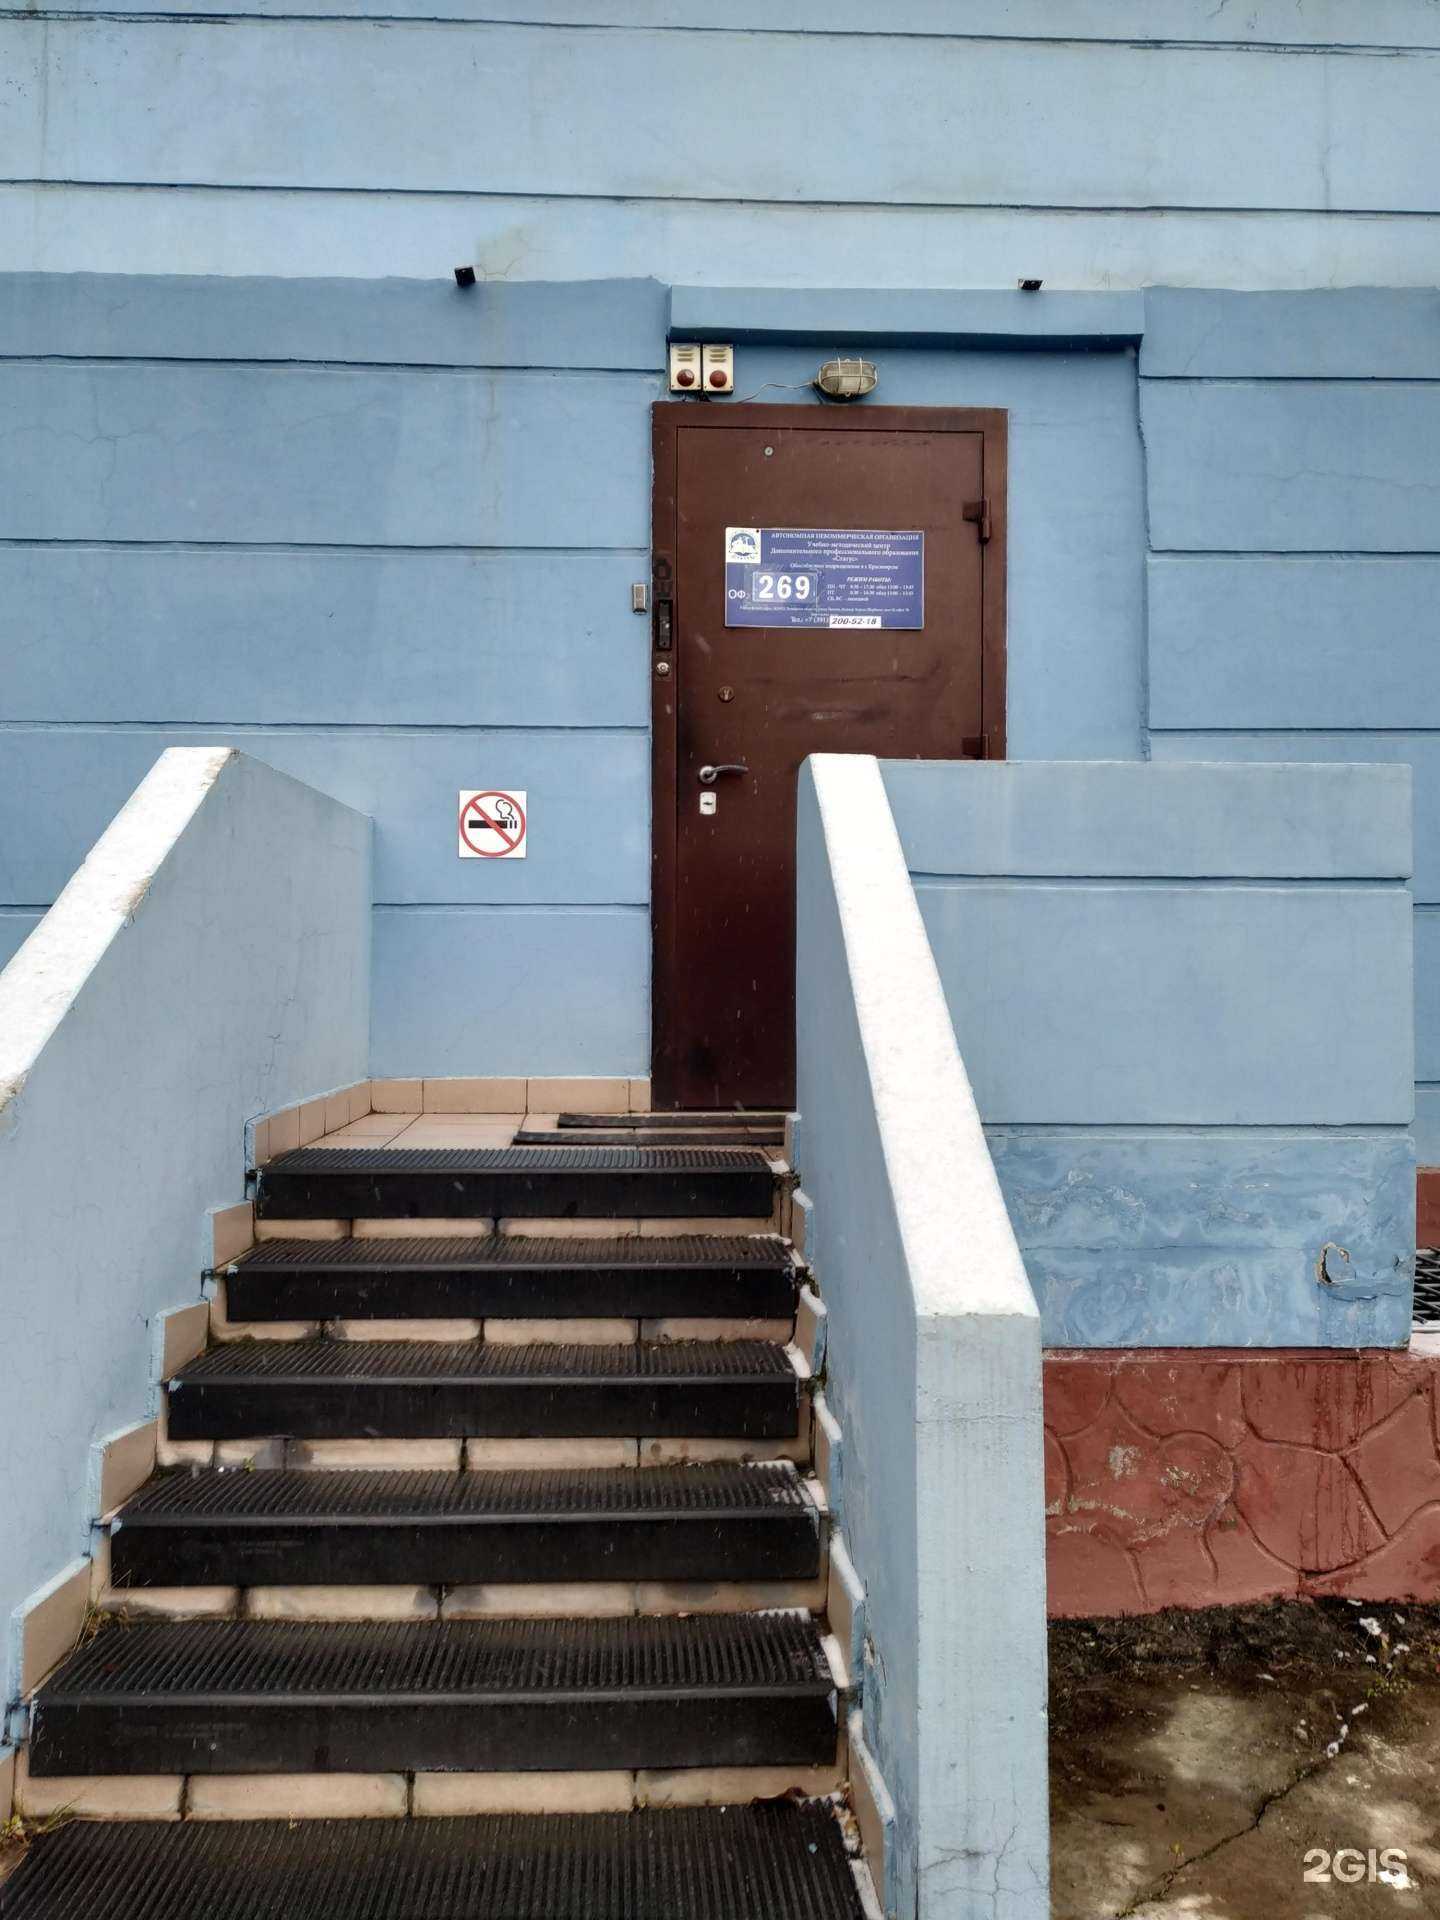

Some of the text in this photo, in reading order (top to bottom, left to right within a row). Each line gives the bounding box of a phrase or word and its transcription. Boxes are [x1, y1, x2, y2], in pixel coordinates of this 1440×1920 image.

[771, 532, 814, 540] АВТОНОМНАЯ
[758, 575, 810, 600] 269
[832, 617, 878, 625] 200-52-18
